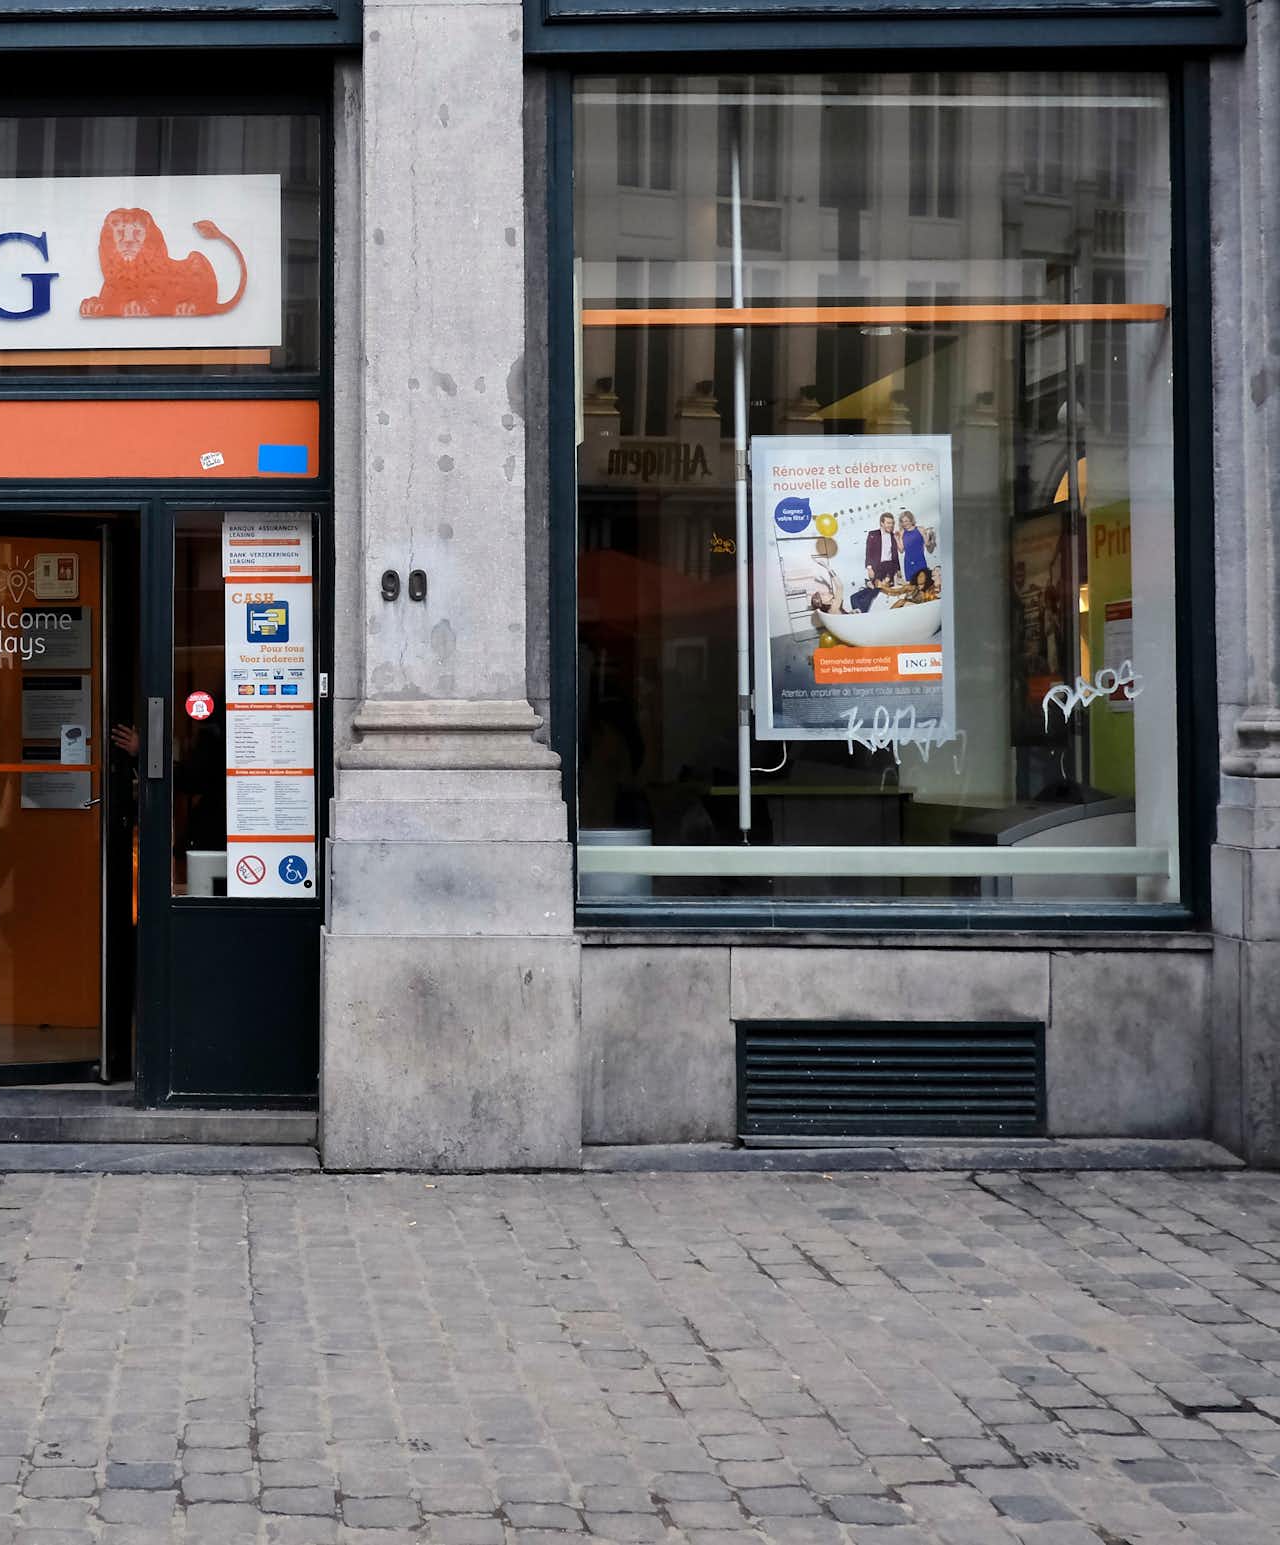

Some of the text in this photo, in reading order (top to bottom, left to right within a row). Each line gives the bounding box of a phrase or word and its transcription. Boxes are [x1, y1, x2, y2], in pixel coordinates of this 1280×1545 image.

[773, 461, 936, 477] Rénovez et célébrez votre
[773, 475, 911, 491] nouvelle salle de bain
[782, 508, 804, 516] Gagnez
[231, 592, 276, 605] CASH
[260, 644, 305, 653] Pour tous
[239, 655, 305, 663] Voor iedereen
[905, 659, 928, 668] ING
